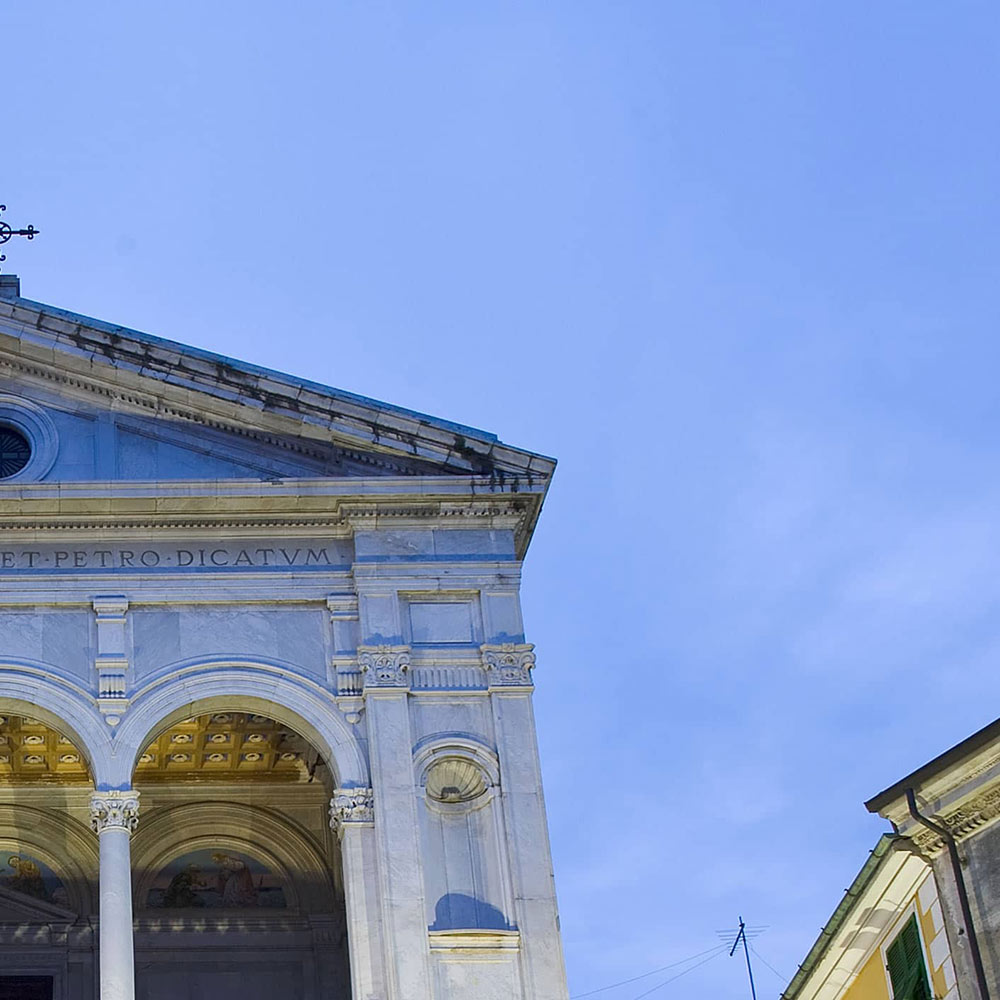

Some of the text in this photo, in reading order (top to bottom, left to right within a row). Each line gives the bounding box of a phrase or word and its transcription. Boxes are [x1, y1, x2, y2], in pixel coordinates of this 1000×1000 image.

[1, 550, 40, 568] ET
[54, 549, 160, 568] PETRO
[177, 548, 333, 567] DICATVM
